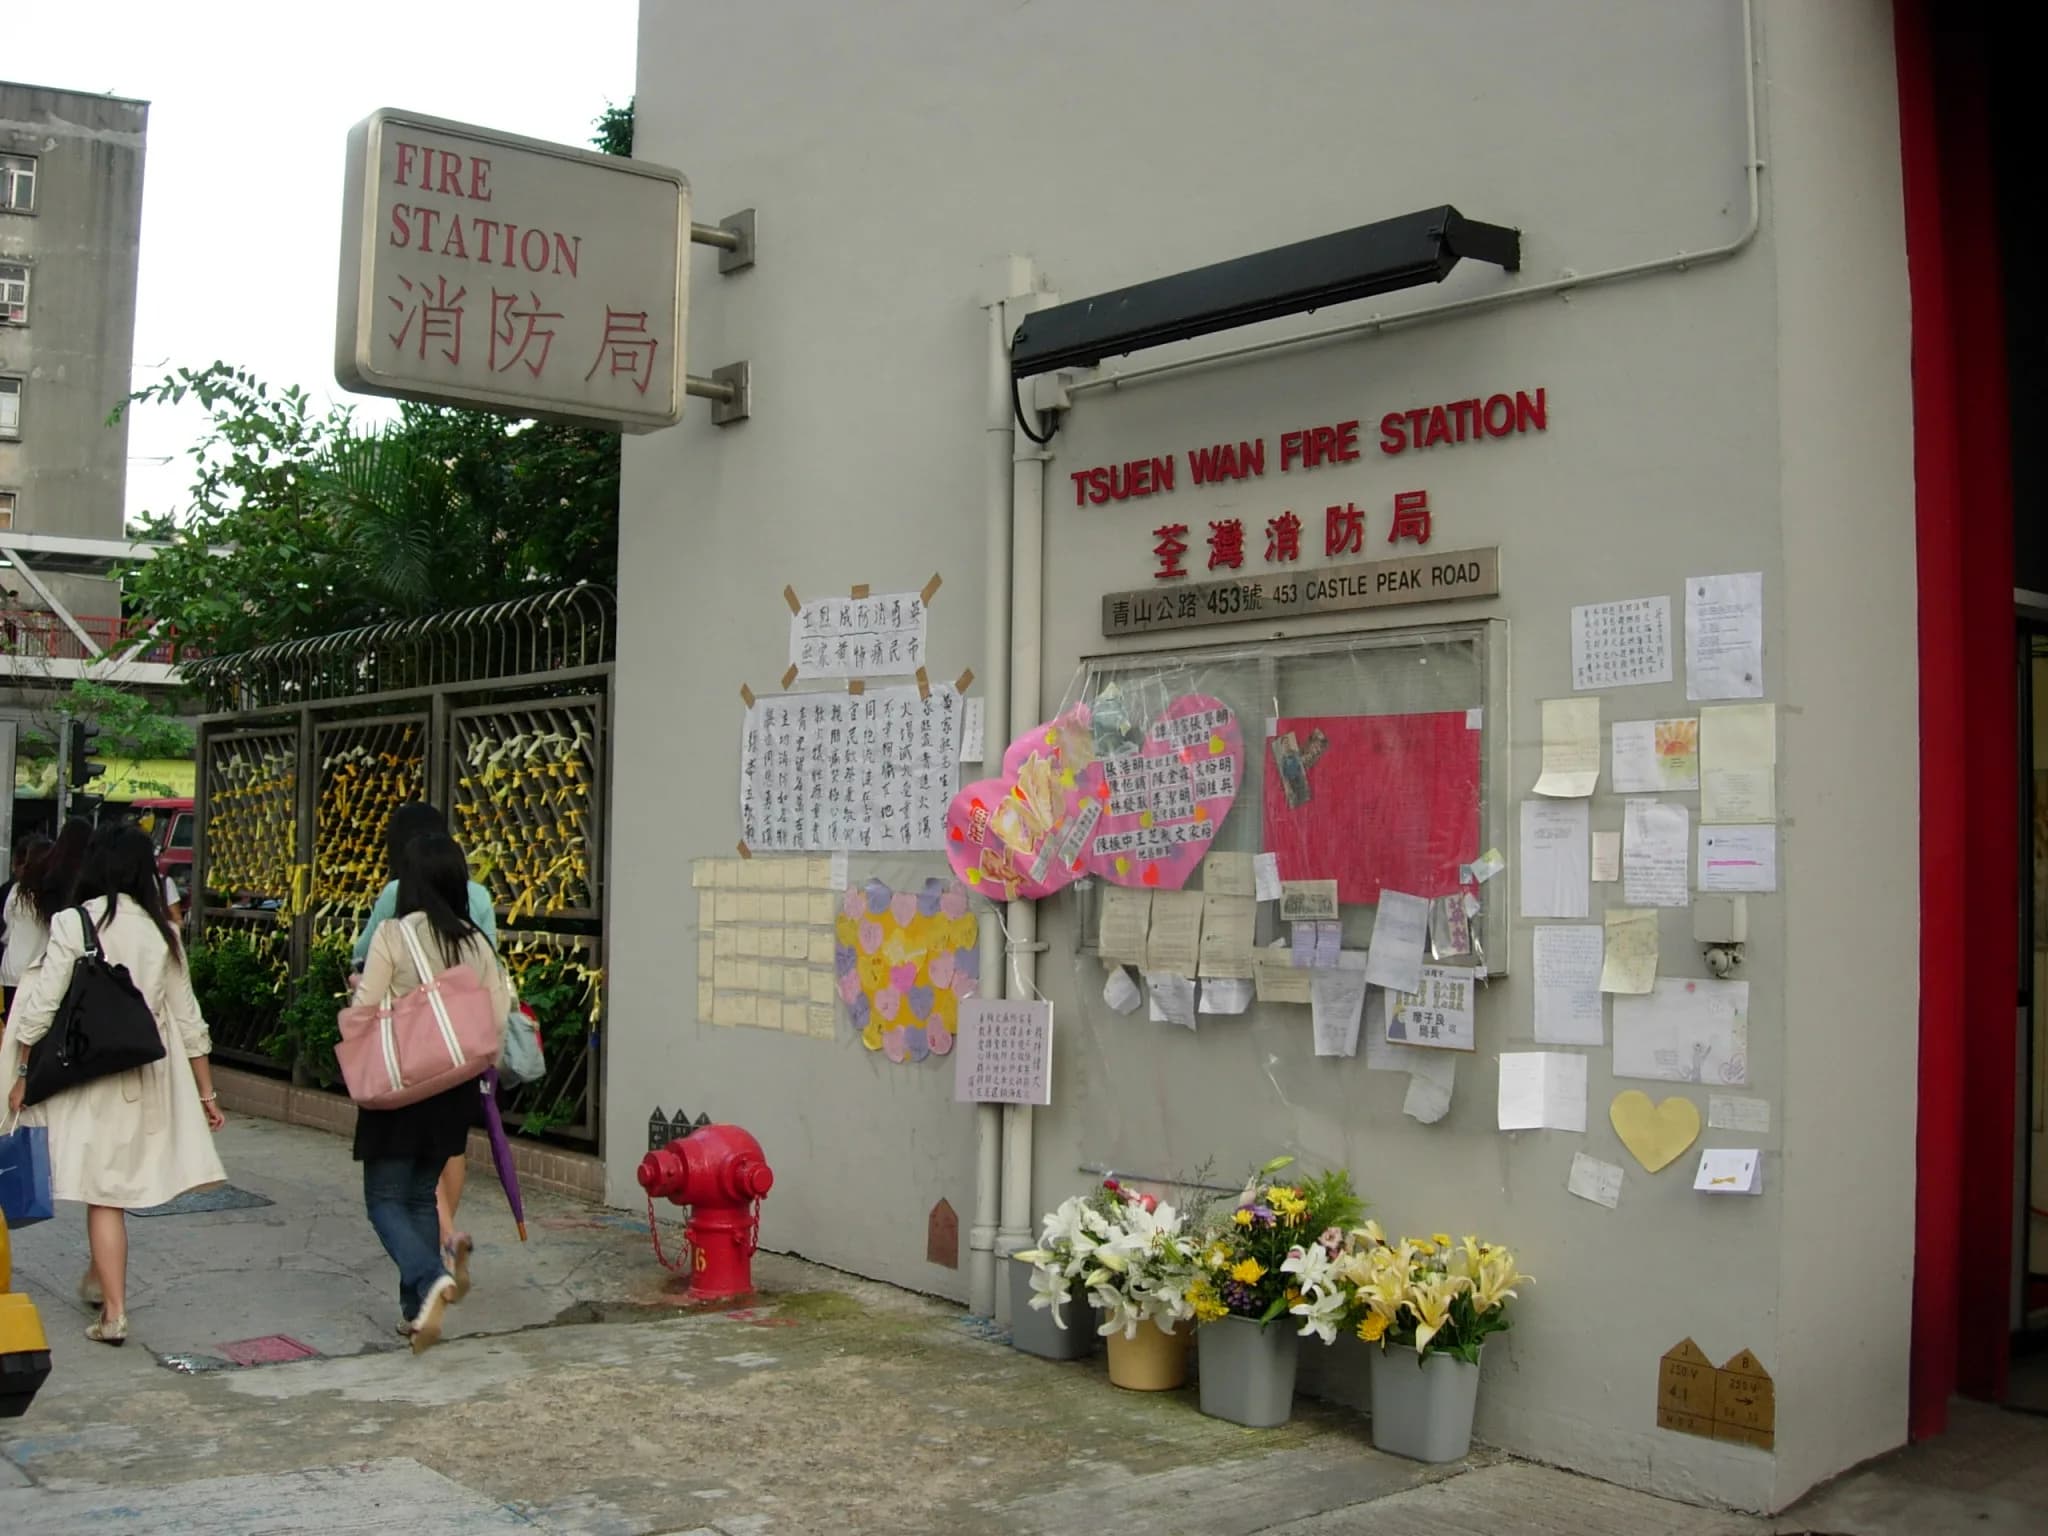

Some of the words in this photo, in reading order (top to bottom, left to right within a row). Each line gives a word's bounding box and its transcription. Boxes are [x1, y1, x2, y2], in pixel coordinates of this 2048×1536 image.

[393, 142, 493, 202] FIRE
[389, 202, 582, 279] STATION
[387, 275, 659, 395] 消防局
[1071, 455, 1175, 507] TSUEN
[1188, 438, 1265, 485] WAN
[1280, 420, 1360, 472] FIRE
[1379, 387, 1547, 455] STATION
[1151, 489, 1433, 579] 荃灣消防局
[1112, 590, 1197, 628] 青山公路
[1272, 584, 1298, 606] 453
[1305, 574, 1368, 602] CASTLE
[1376, 568, 1422, 593] PEAK
[1431, 561, 1481, 587] ROAD
